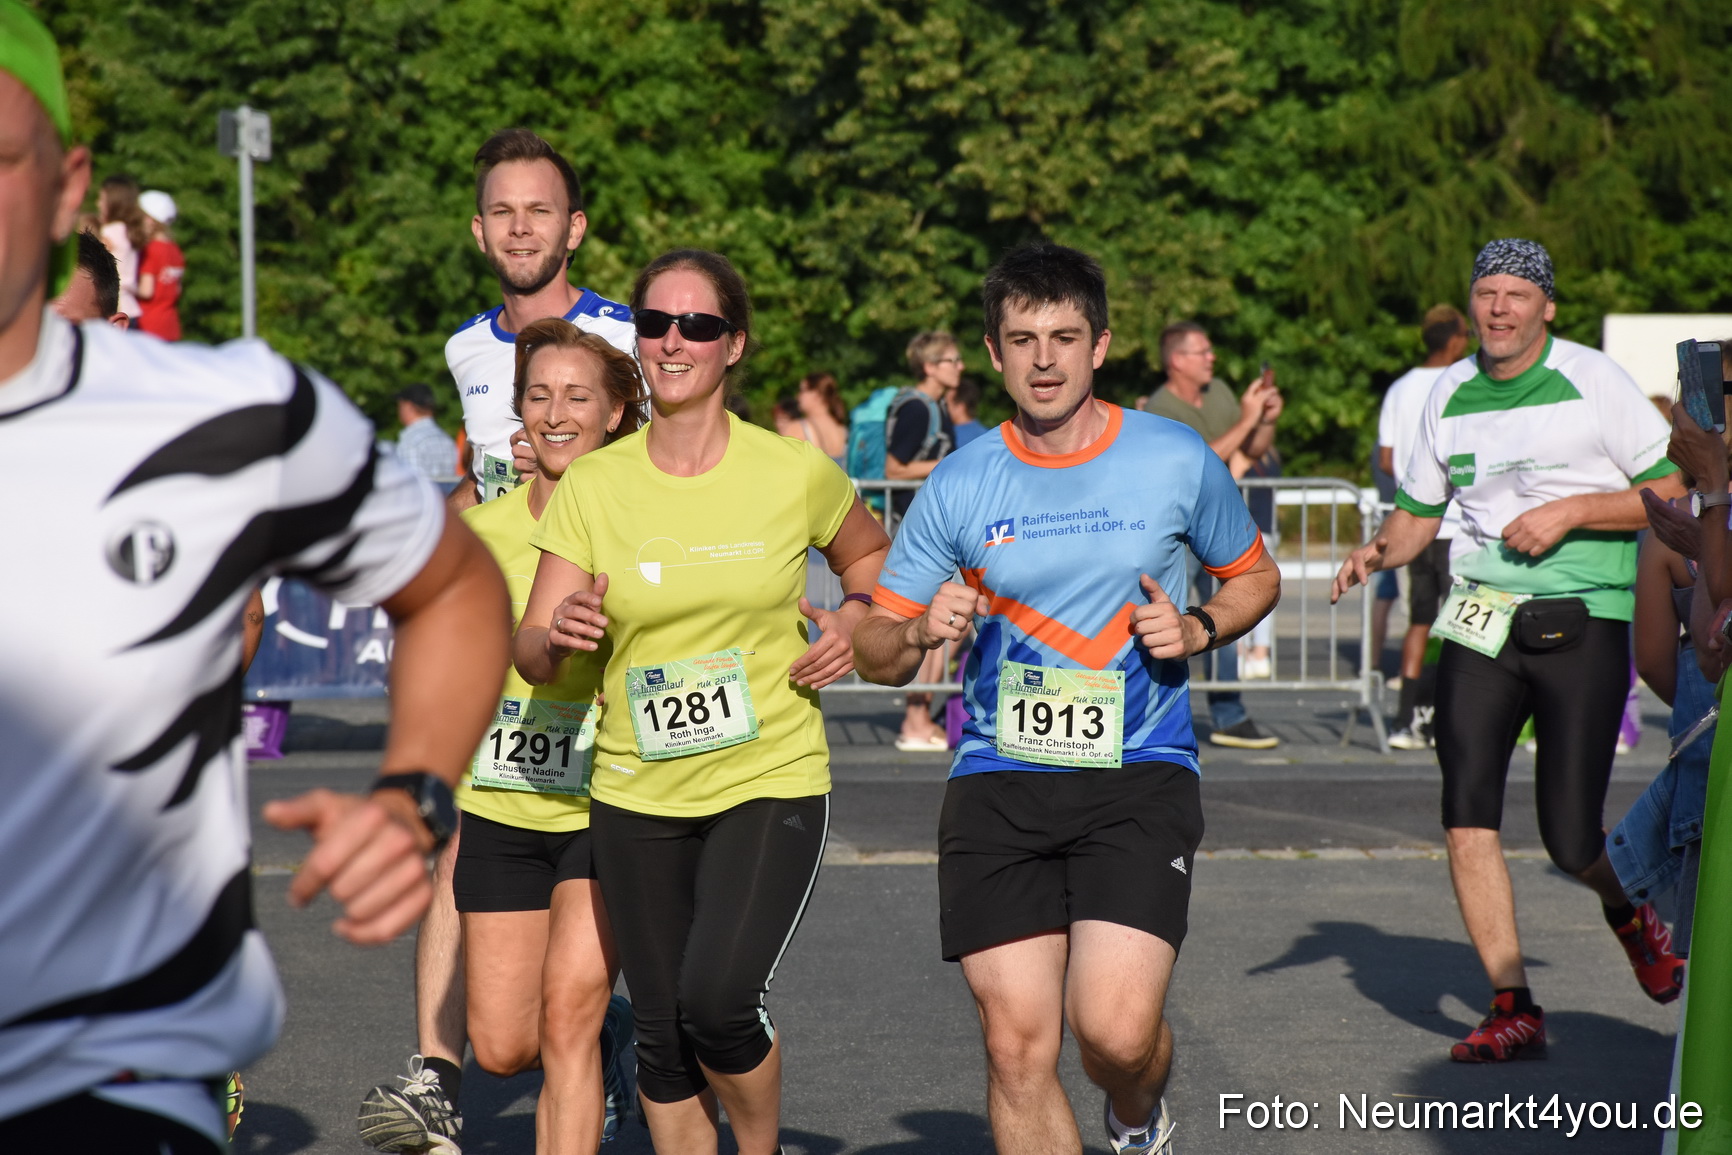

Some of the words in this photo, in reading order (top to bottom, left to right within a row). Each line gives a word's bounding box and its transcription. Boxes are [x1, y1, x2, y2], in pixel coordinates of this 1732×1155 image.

[466, 384, 489, 397] JAKO
[1022, 507, 1109, 526] Raiffeisenbank
[1022, 524, 1081, 540] Neumarkt
[1084, 520, 1126, 533] i.d.OPf.
[1129, 519, 1146, 531] eG
[689, 544, 716, 553] Kliniken
[710, 549, 742, 558] Neumarkt
[1455, 600, 1493, 631] 121
[641, 677, 684, 694] firmenlauf
[715, 673, 737, 686] 2019
[1015, 681, 1062, 696] firmenlauf
[644, 685, 731, 732] 1281
[1091, 696, 1115, 705] 2019
[1012, 699, 1104, 739] 1913
[563, 727, 586, 736] 2019
[669, 728, 692, 740] Roth
[694, 725, 715, 737] Inga
[489, 728, 571, 768] 1291
[665, 739, 691, 749] Klinikum
[693, 732, 724, 744] Neumarkt
[1018, 735, 1044, 746] Franz
[1046, 739, 1095, 751] Christoph
[1002, 741, 1042, 753] Raiffeisenbank
[1044, 748, 1074, 757] Neumarkt
[493, 762, 530, 775] Schuster
[532, 766, 565, 778] Nadine
[499, 773, 525, 781] Klinikum
[525, 775, 555, 784] Neumarkt
